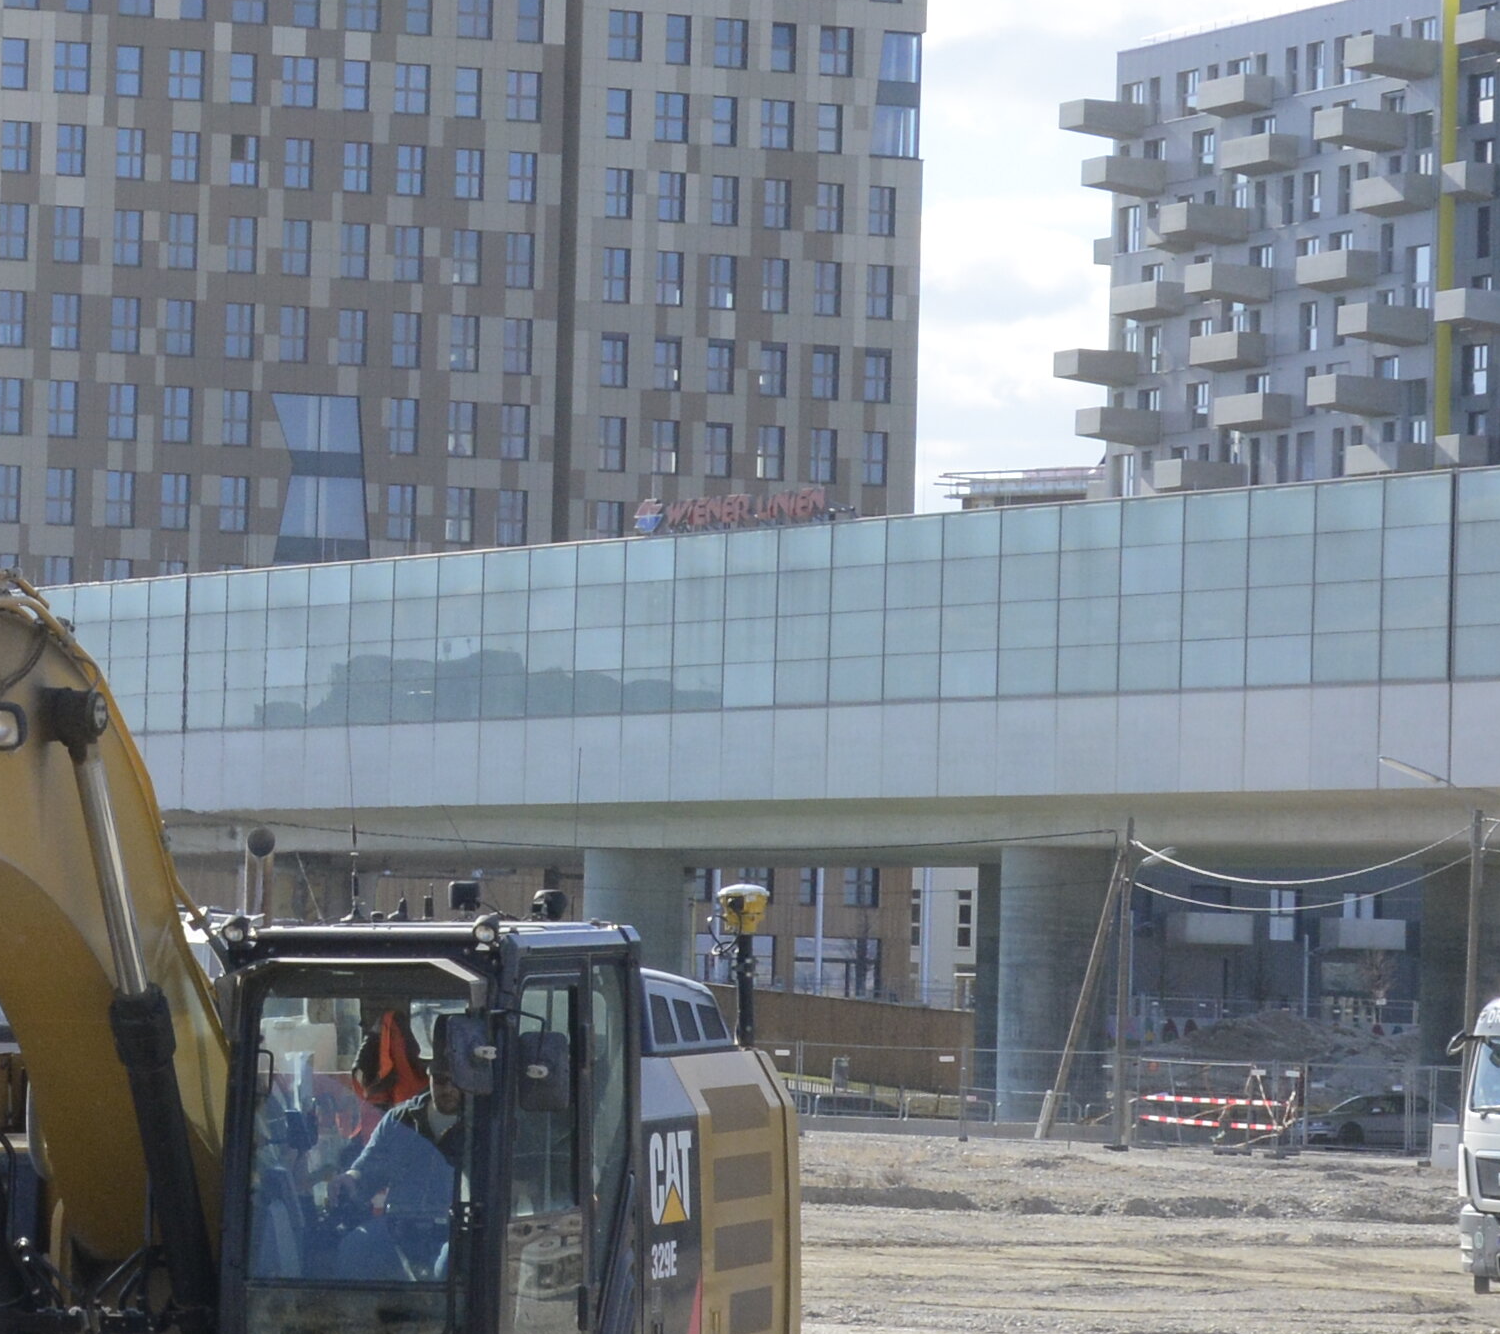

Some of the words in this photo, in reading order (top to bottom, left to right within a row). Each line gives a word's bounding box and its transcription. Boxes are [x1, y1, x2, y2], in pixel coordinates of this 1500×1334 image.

[667, 493, 750, 526] WIENER
[756, 486, 825, 521] LINIEN
[649, 1129, 693, 1226] CAT
[651, 1239, 677, 1281] 329E
